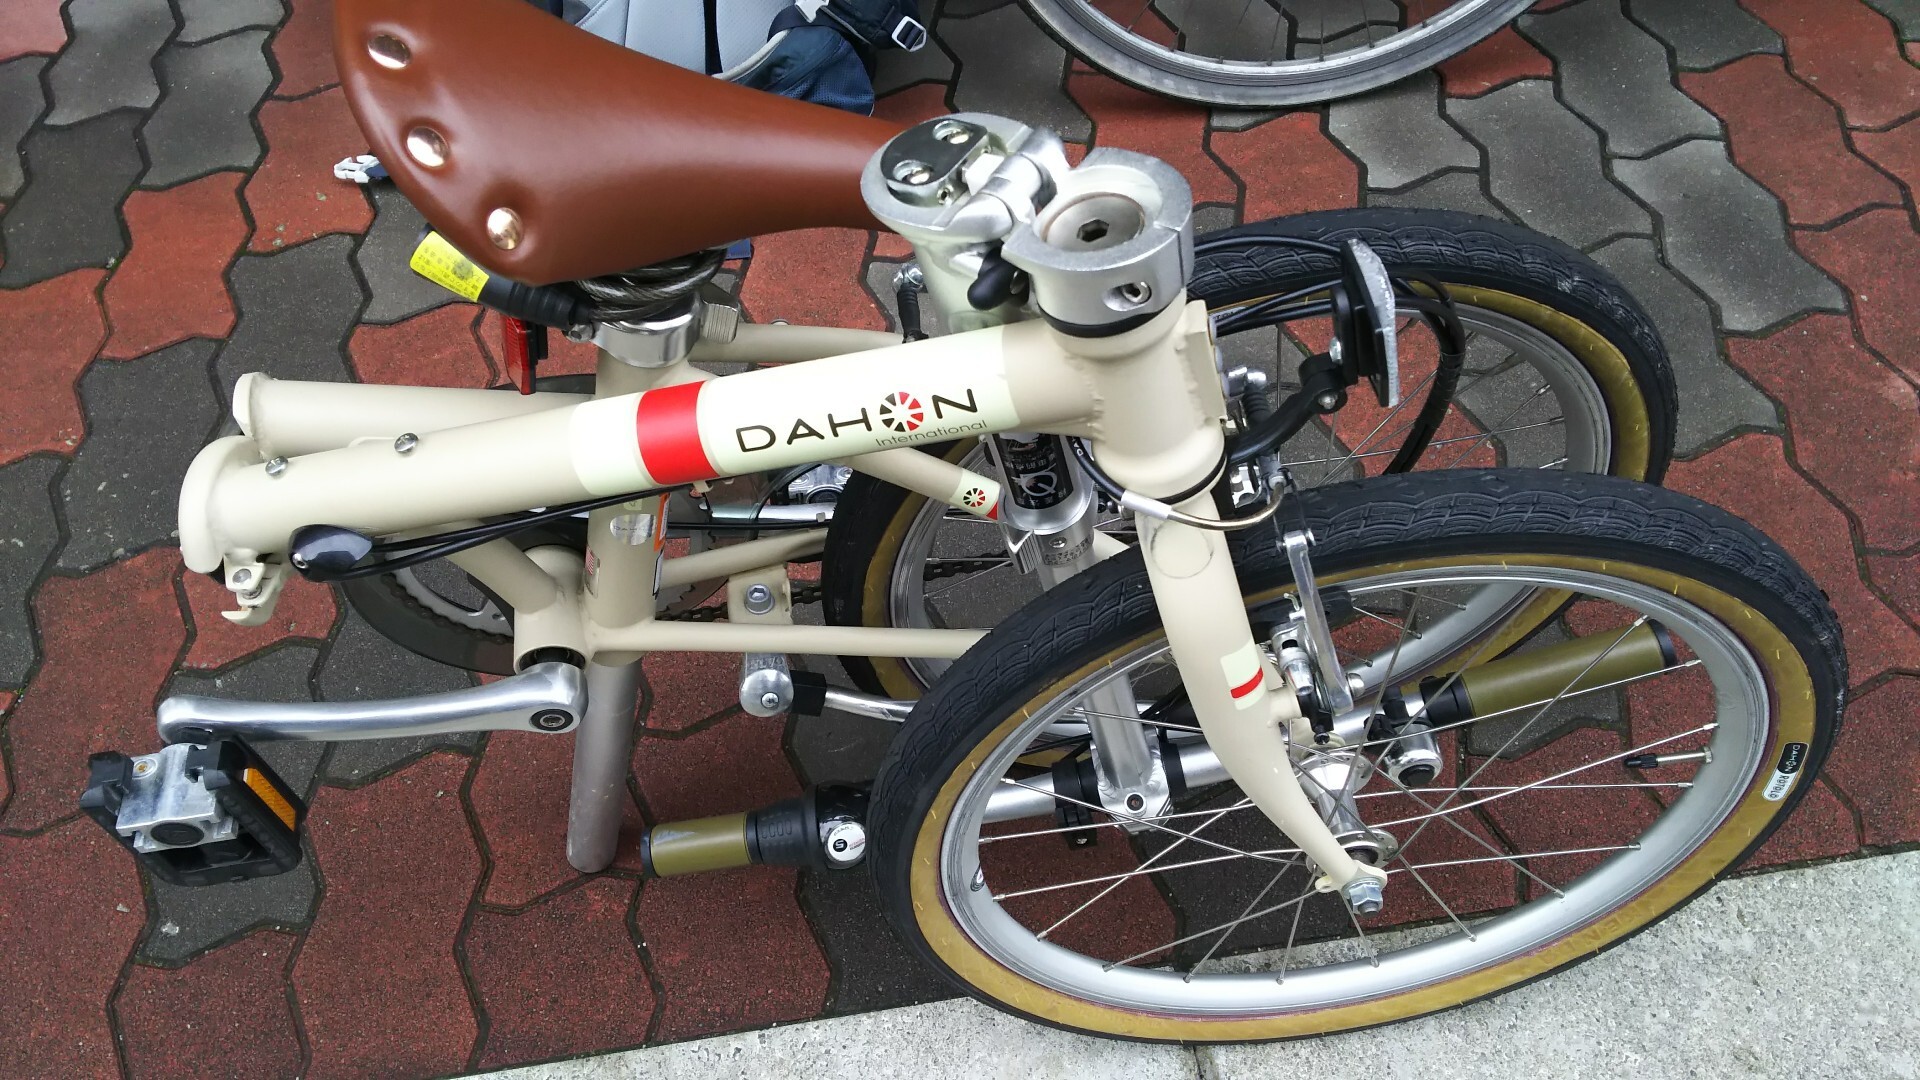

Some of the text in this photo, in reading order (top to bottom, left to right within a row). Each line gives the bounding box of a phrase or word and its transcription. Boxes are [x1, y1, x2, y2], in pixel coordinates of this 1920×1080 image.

[735, 388, 978, 453] DAHON
[875, 418, 987, 447] International
[1784, 744, 1801, 772] DAHON
